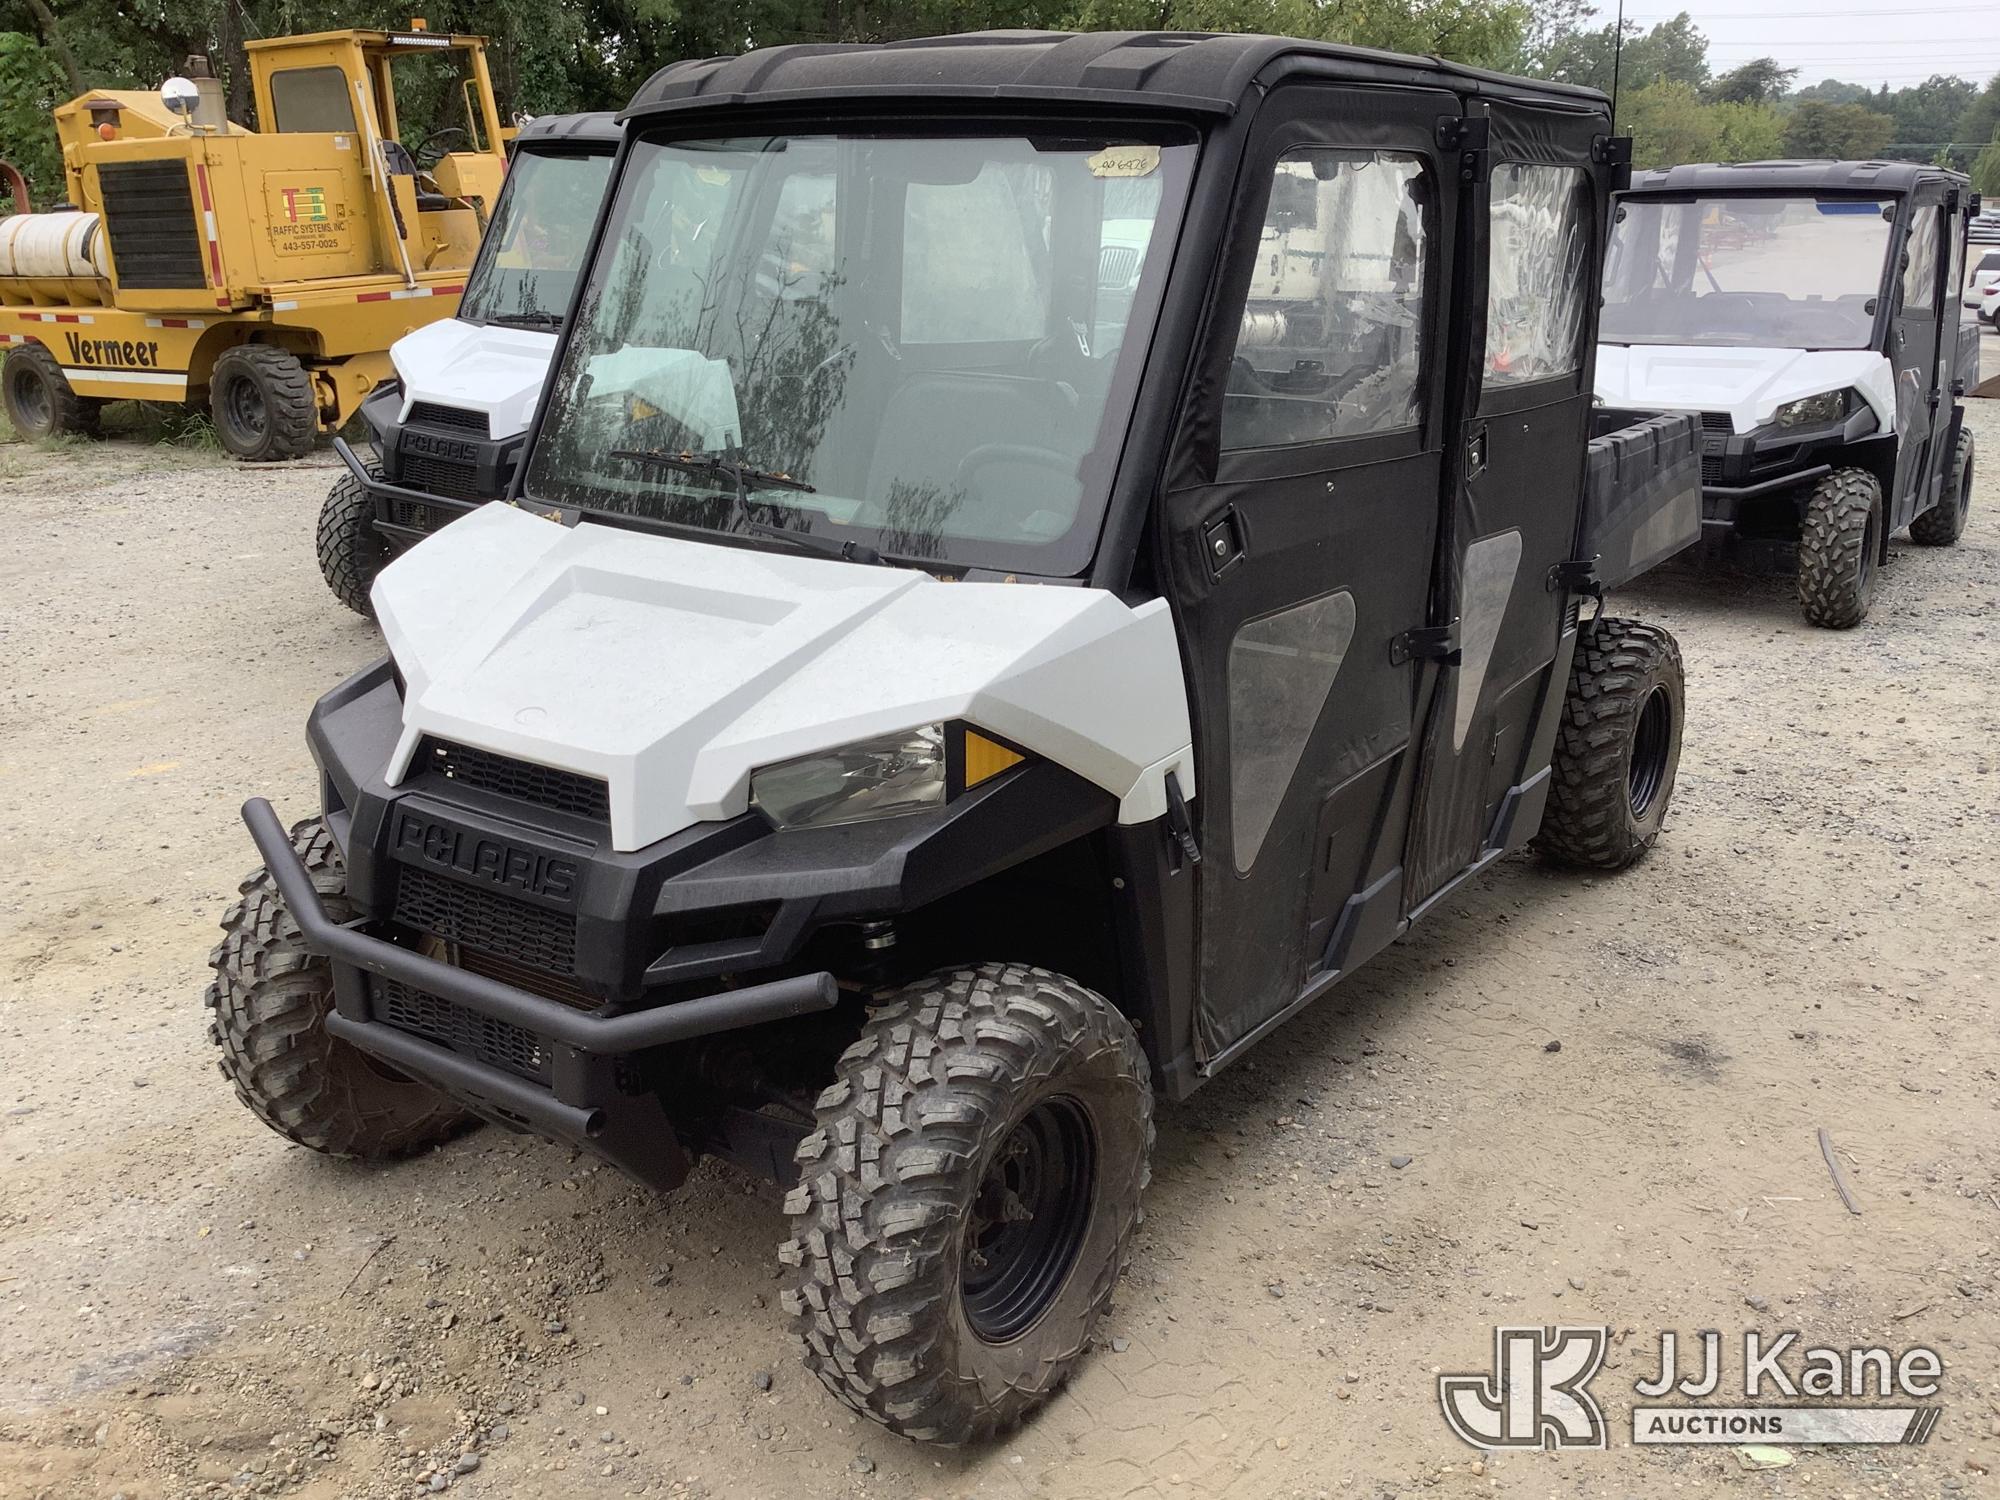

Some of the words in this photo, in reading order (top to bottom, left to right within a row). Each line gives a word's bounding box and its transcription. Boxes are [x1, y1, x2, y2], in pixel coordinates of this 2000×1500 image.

[283, 239, 338, 251] 443-557-0025
[65, 331, 159, 367] Vermeer
[404, 433, 478, 463] POLARIS
[397, 814, 577, 902] POLARIS
